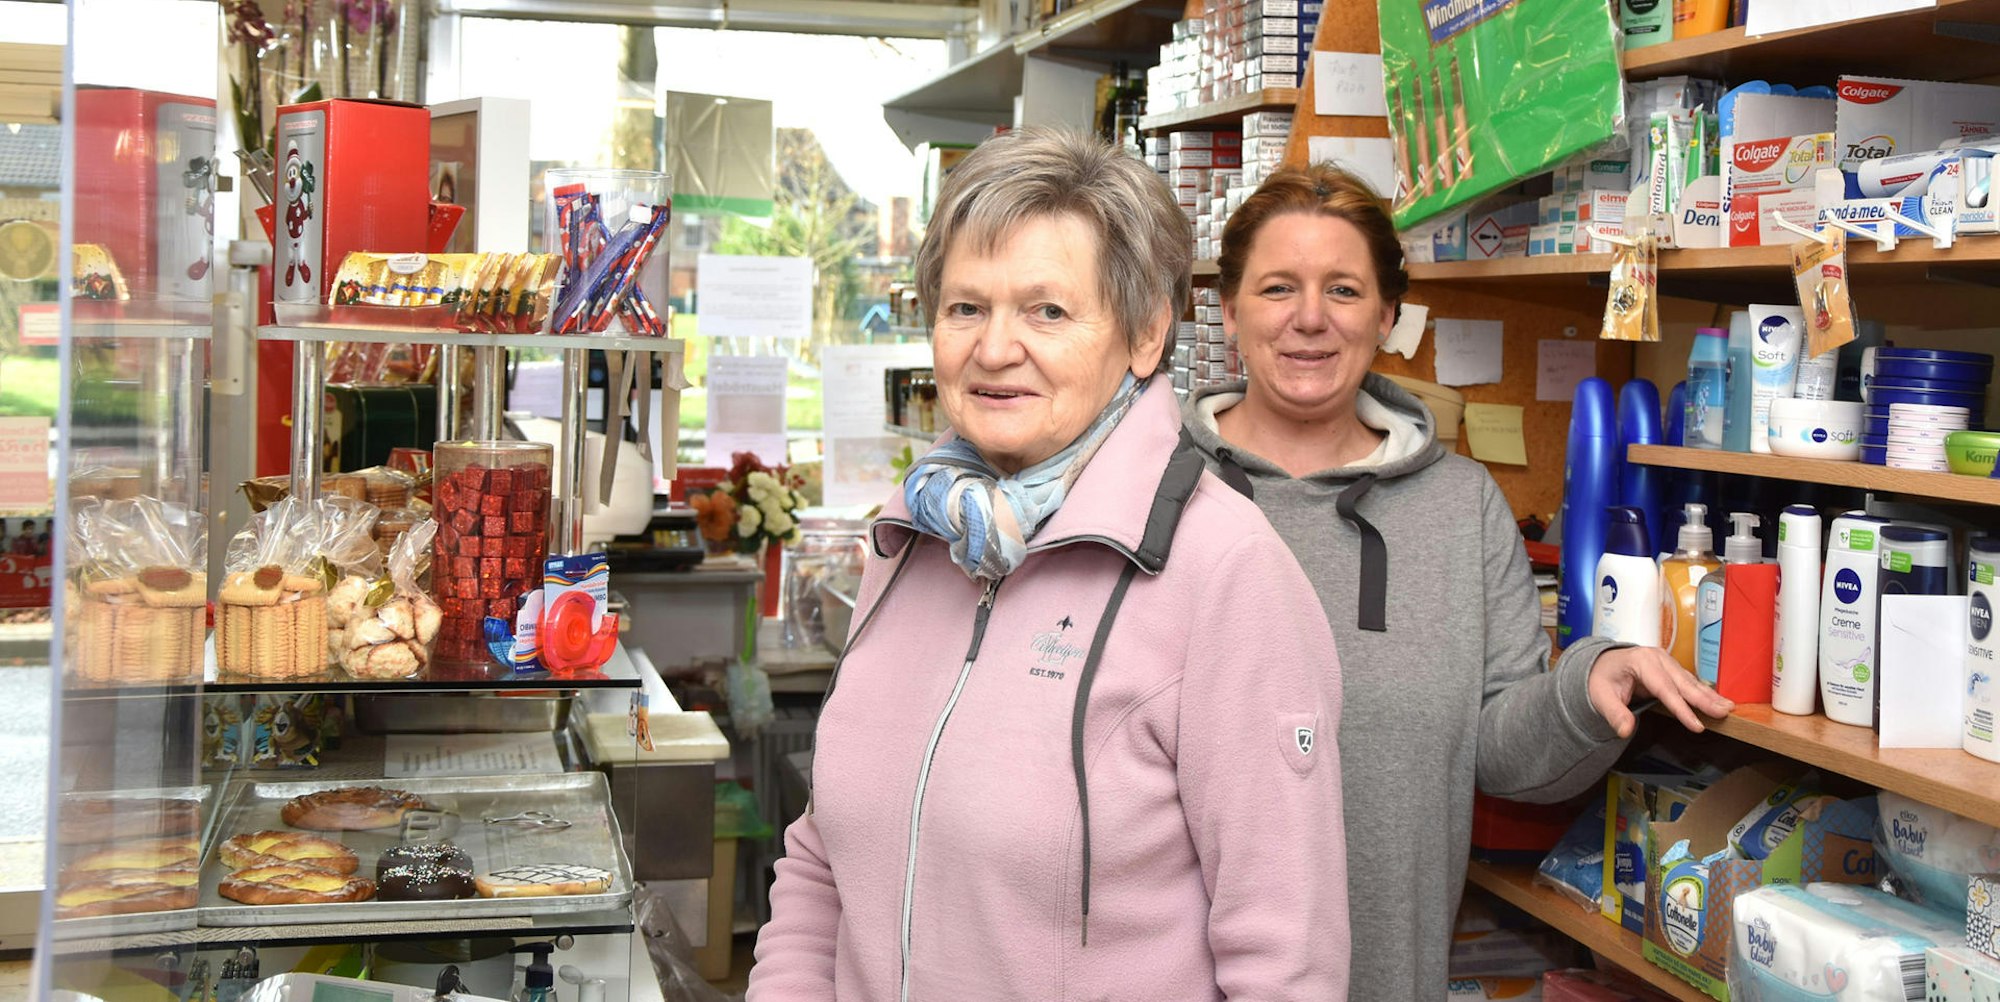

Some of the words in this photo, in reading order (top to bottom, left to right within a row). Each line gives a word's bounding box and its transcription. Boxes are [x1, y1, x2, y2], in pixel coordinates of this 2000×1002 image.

[1841, 85, 1889, 100] Colgate
[1735, 144, 1781, 163] Colgate
[1846, 144, 1892, 159] Total
[1947, 164, 1960, 175] 24
[1651, 153, 1668, 217] entagard
[1599, 193, 1629, 203] elme
[1929, 206, 1954, 216] CLEAN
[1757, 349, 1787, 361] Soft
[1835, 580, 1860, 592] NIVEA
[1970, 606, 1991, 620] NIVEA
[1831, 616, 1861, 630] Creme
[1893, 818, 1925, 852] Baby
[1666, 902, 1697, 932] Cottonelle
[1747, 924, 1776, 962] Baby
